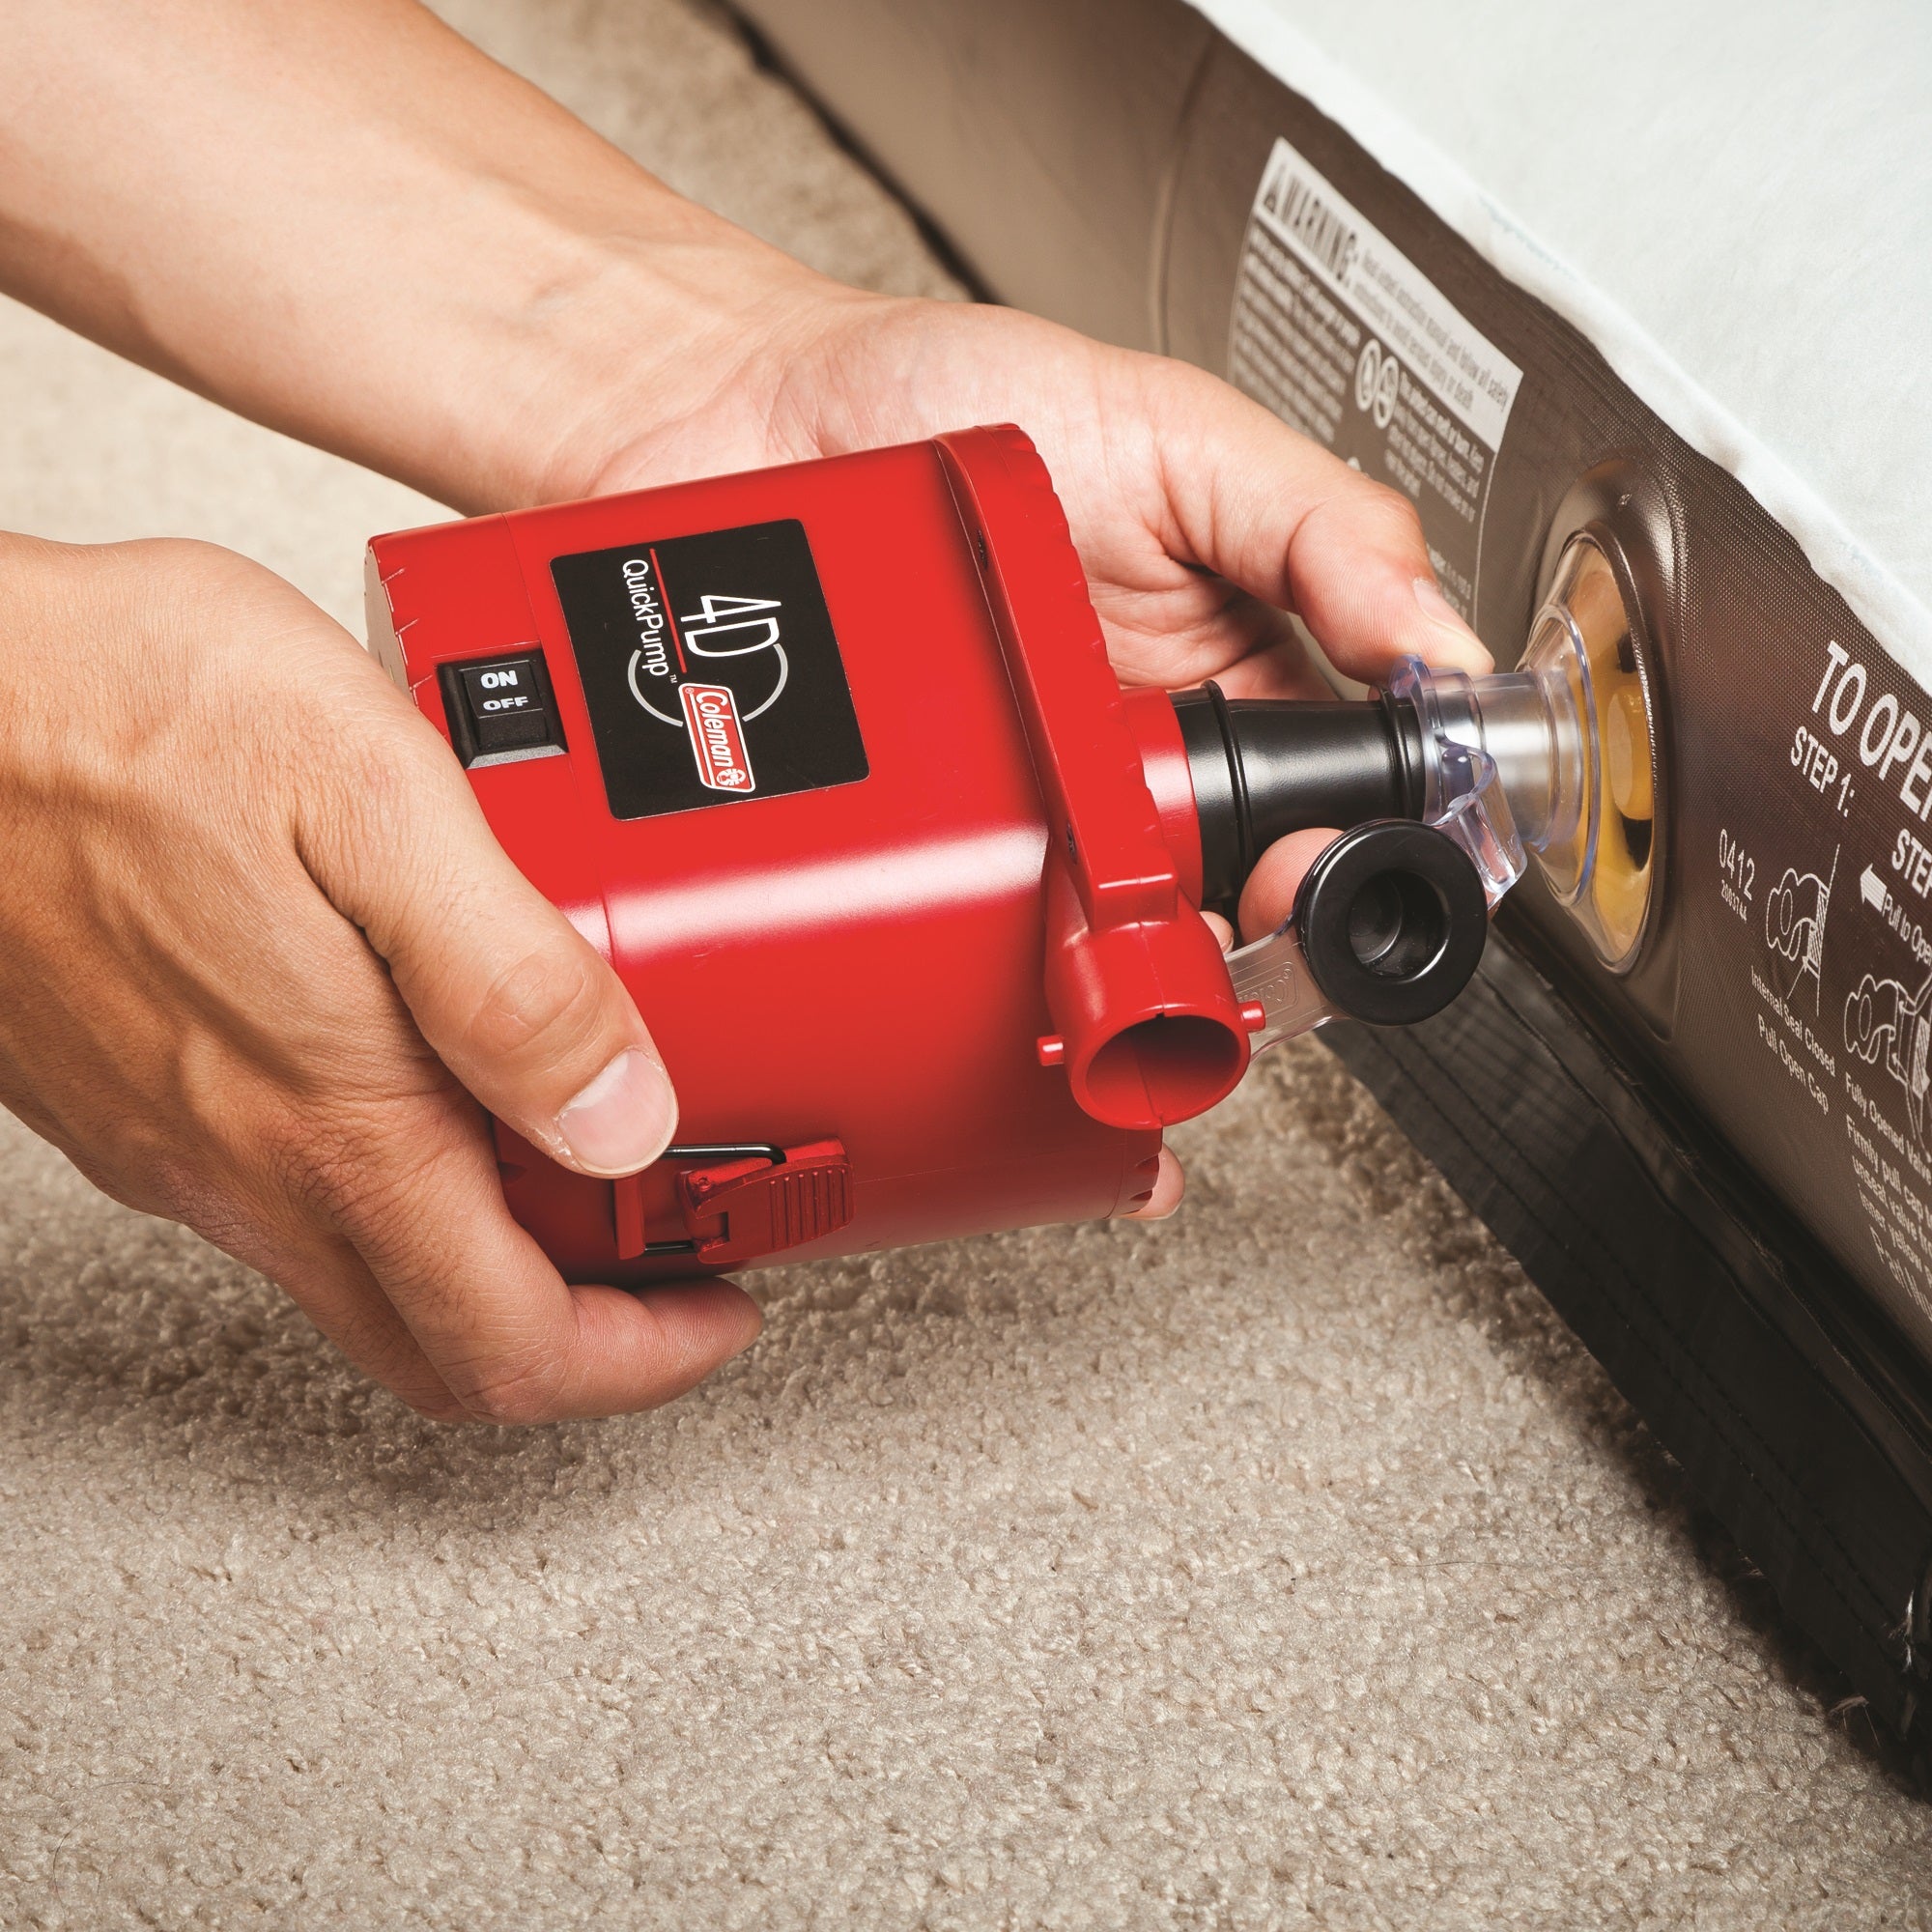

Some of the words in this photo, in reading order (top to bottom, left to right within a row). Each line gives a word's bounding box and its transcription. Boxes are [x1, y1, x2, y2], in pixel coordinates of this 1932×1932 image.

[622, 558, 669, 677] QuickPump
[680, 594, 781, 657] 4D
[480, 669, 518, 689] ON
[483, 696, 528, 711] OFF
[696, 691, 734, 767] Coleman
[1811, 639, 1867, 735] TO
[1860, 694, 1932, 822] OPE
[1790, 725, 1839, 794] STEP
[1837, 773, 1856, 818] 1:
[1719, 828, 1755, 901] 0412
[1882, 893, 1903, 932] Pull
[1900, 913, 1911, 943] to
[1751, 964, 1783, 1017] Internal
[1784, 1003, 1803, 1041] Seal
[1804, 1027, 1835, 1078] Closed
[1758, 1013, 1778, 1055] Pull
[1779, 1038, 1806, 1087] Open
[1807, 1072, 1829, 1116] Cap
[1846, 1071, 1867, 1118] Fully
[1869, 1099, 1904, 1155] Opened
[1906, 1138, 1932, 1186] Valve
[1846, 1114, 1879, 1174] Firmly
[1881, 1158, 1902, 1196] pull
[1904, 1184, 1924, 1224] cap
[1889, 1196, 1918, 1241] valve
